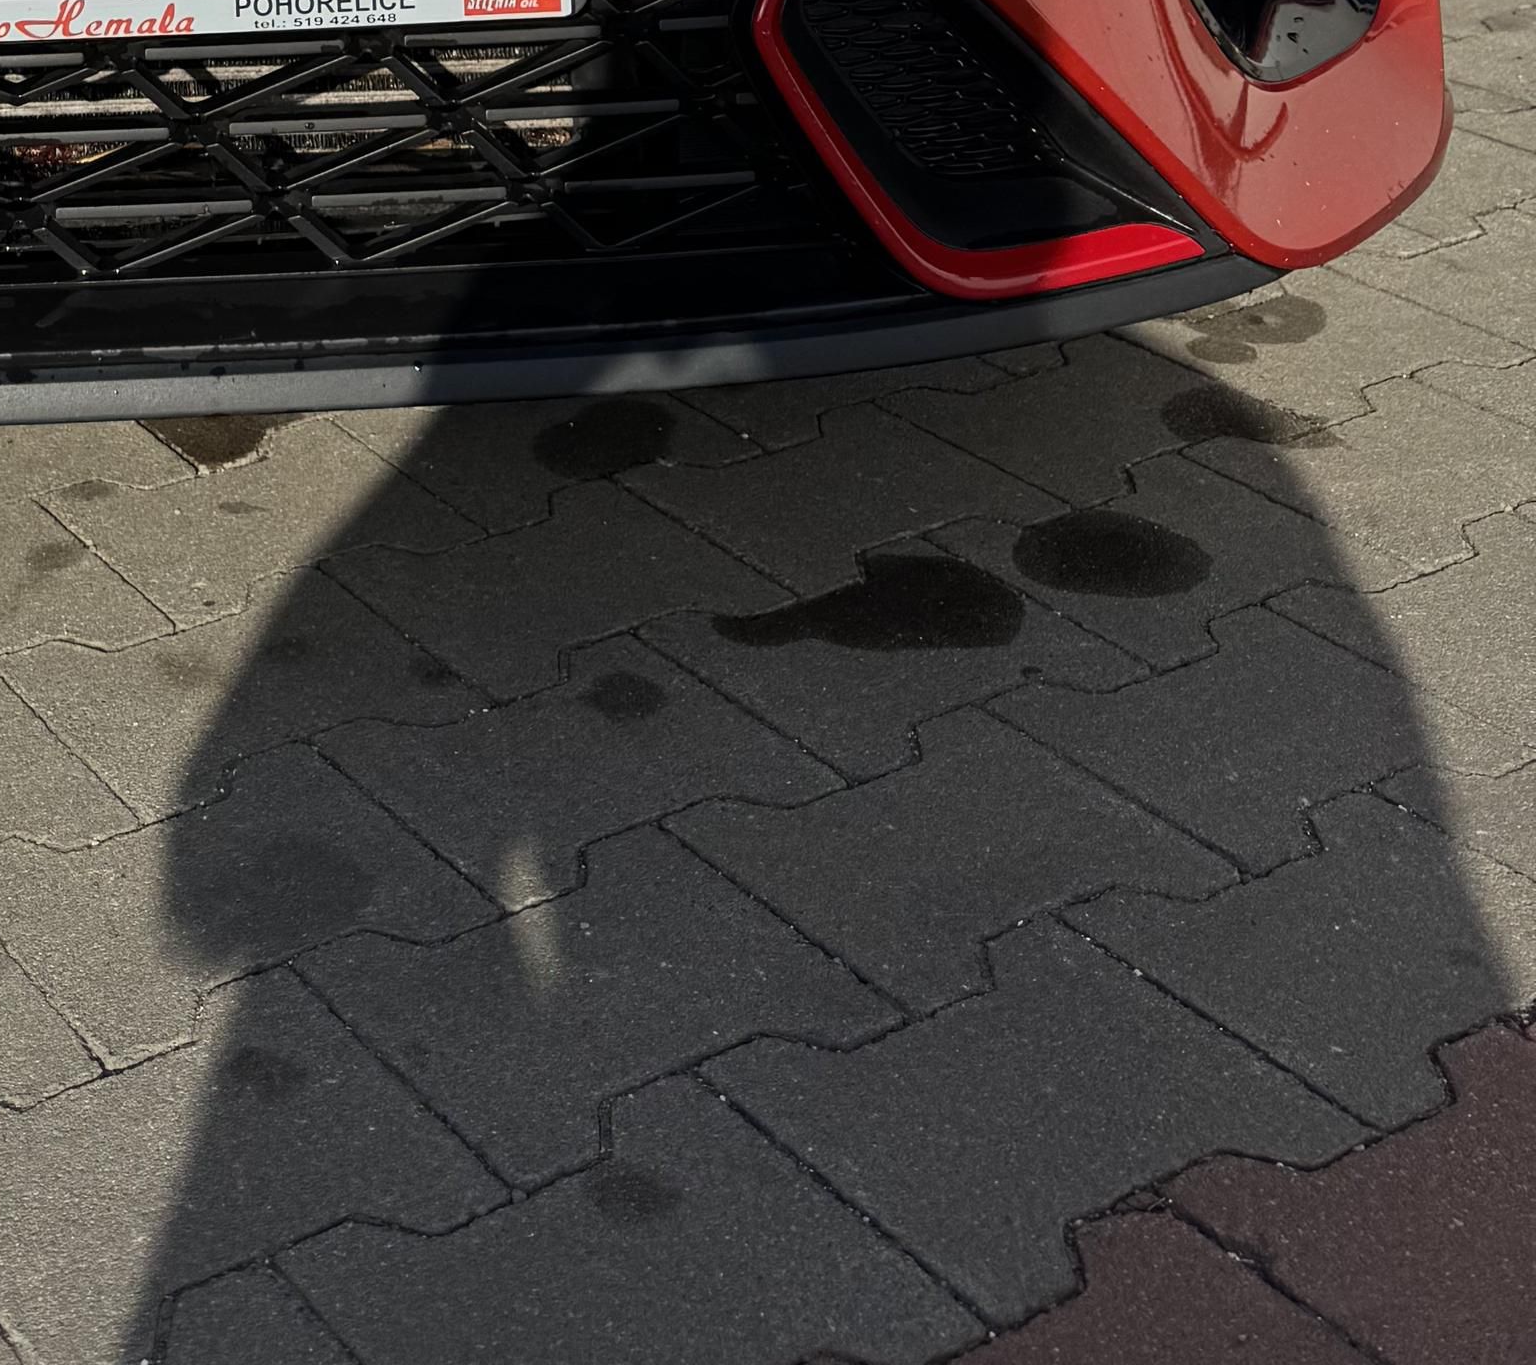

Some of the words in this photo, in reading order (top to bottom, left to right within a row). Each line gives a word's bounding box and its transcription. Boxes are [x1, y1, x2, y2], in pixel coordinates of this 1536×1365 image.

[520, 0, 539, 9] OIL
[14, 0, 195, 39] Hemala
[254, 18, 287, 29] tel.:
[293, 17, 324, 27] 519
[329, 15, 360, 25] 424
[366, 13, 397, 24] 648
